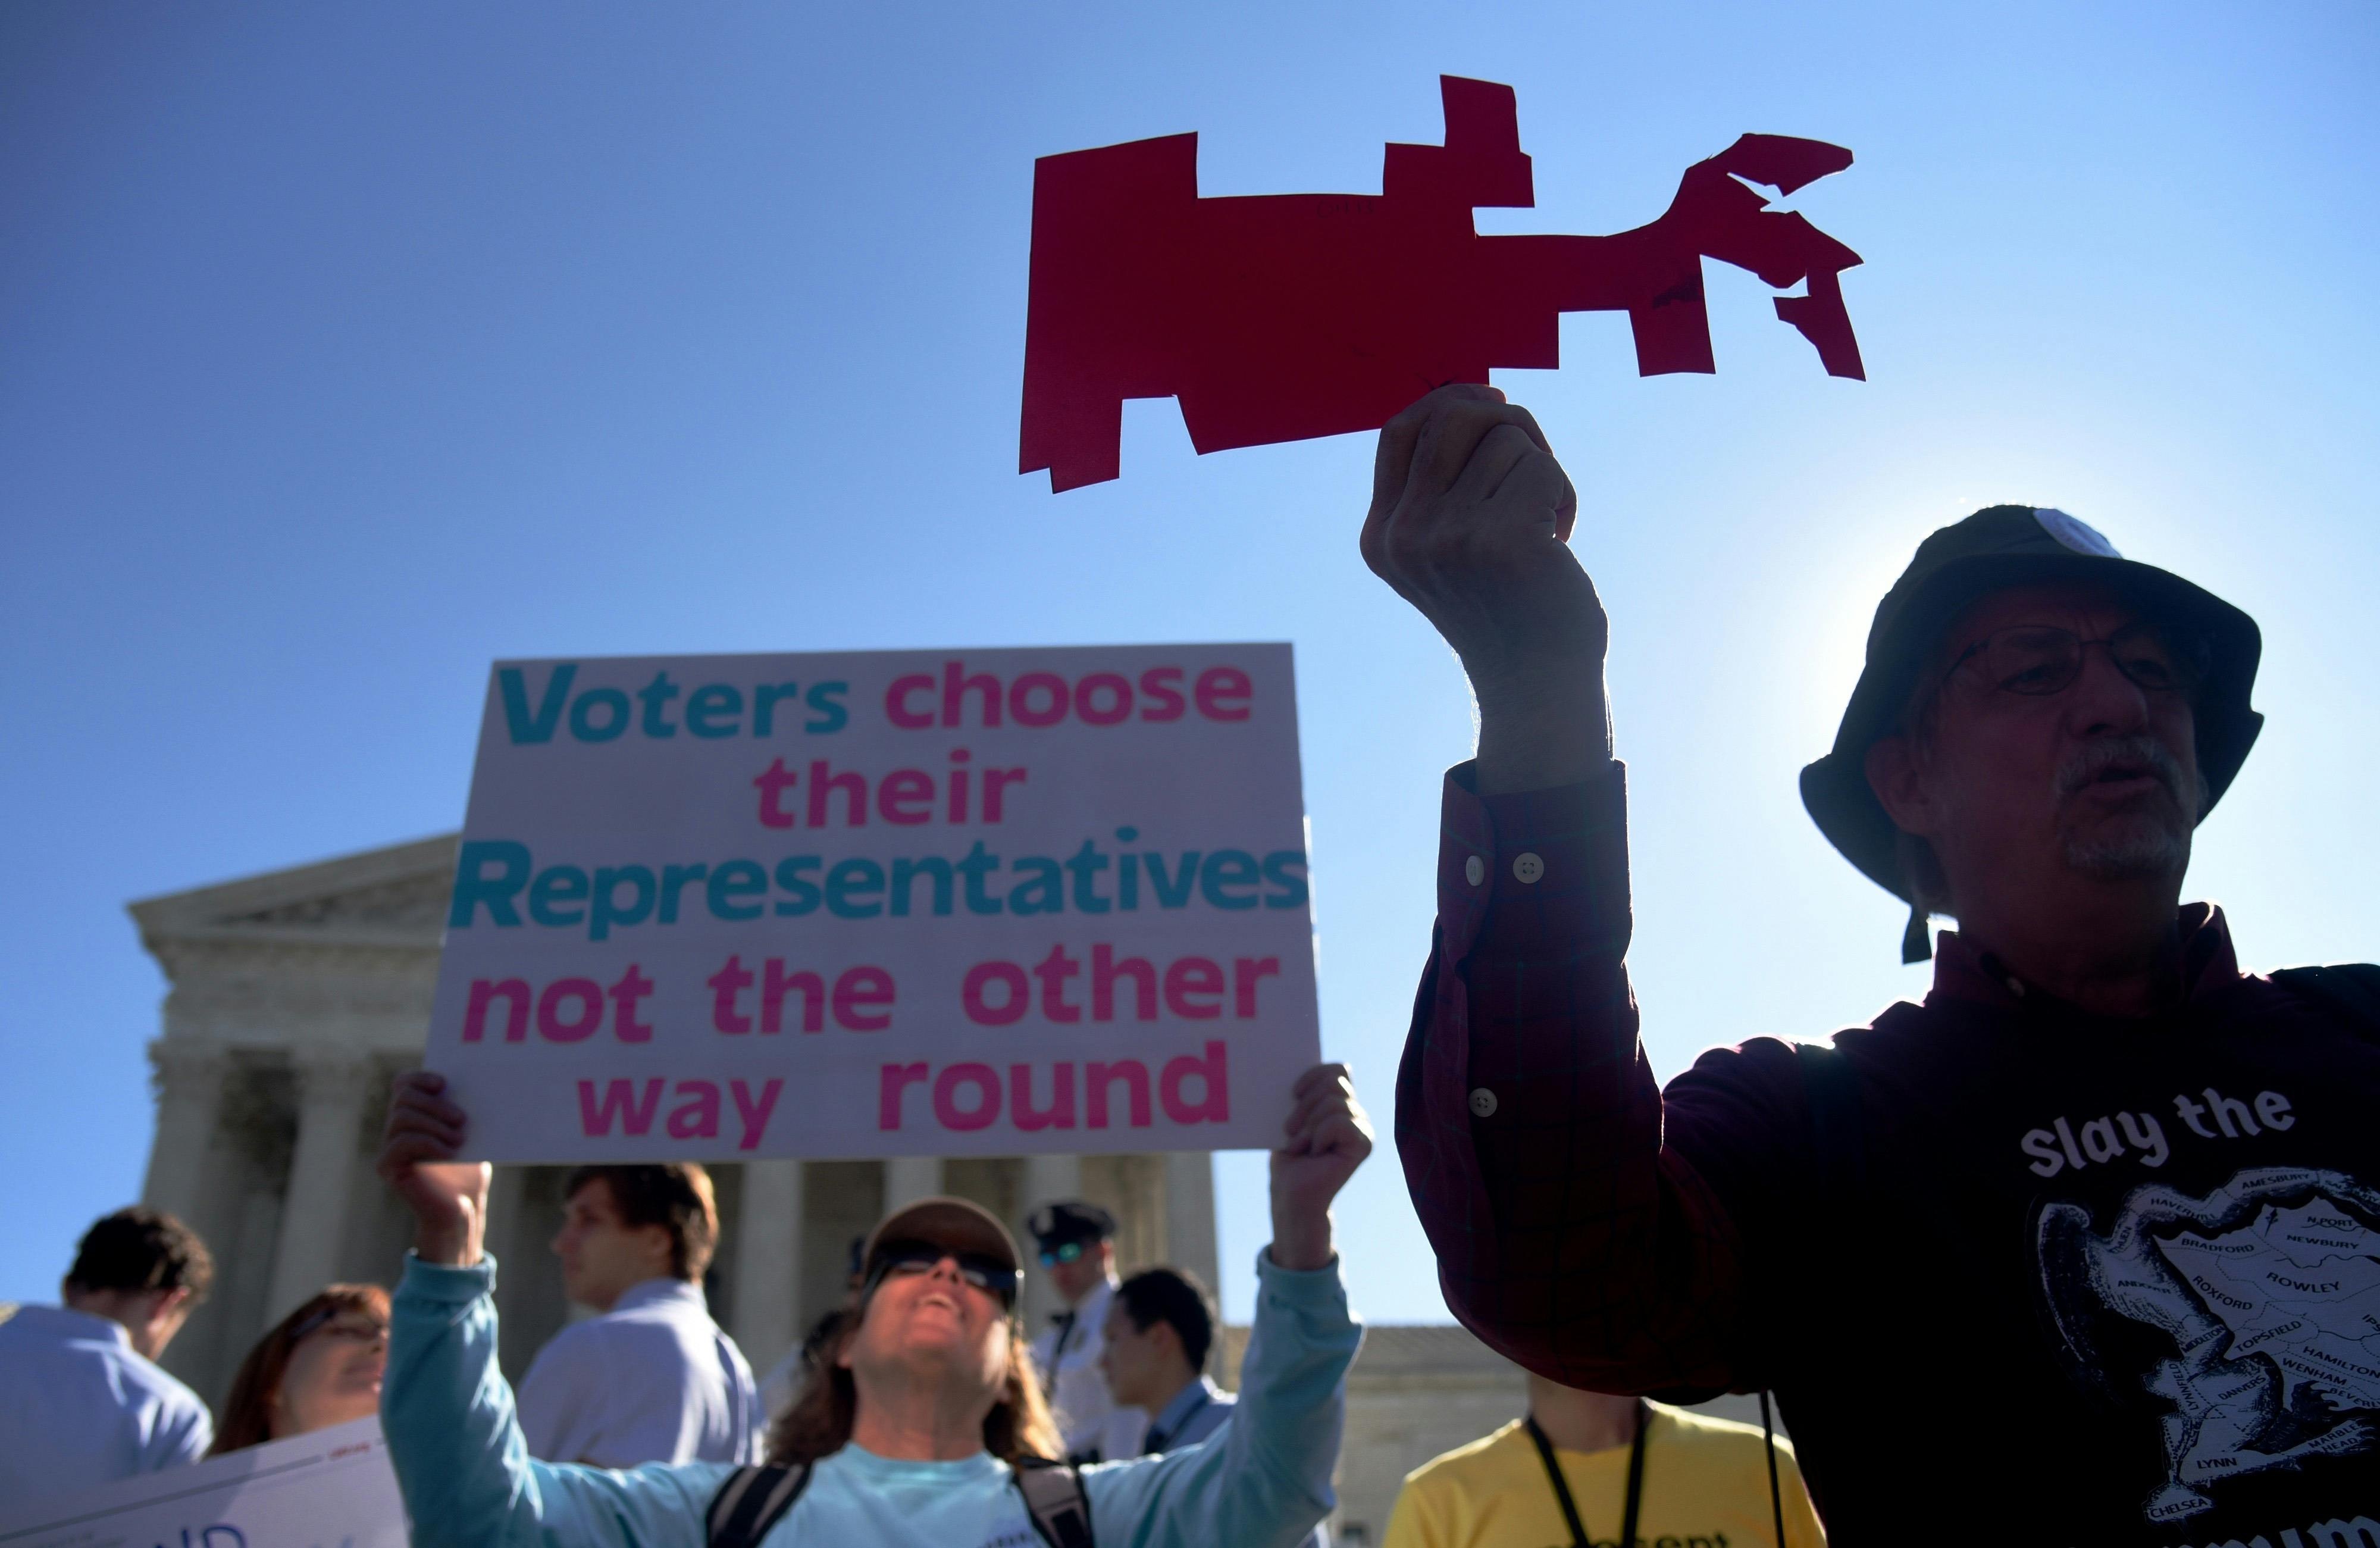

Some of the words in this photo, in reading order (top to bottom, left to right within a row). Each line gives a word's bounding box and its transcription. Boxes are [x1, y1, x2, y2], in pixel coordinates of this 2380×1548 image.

[499, 663, 849, 745] Voters
[885, 662, 1252, 729] choose
[754, 749, 1026, 828] their
[448, 826, 1309, 941] Representatives
[464, 964, 653, 1043] not
[708, 956, 895, 1034] the
[962, 943, 1279, 1026] other
[578, 1077, 783, 1151] way
[879, 1039, 1230, 1133] round
[2173, 1087, 2296, 1139] the
[2242, 1173, 2310, 1190] AMESBURY
[2182, 1238, 2254, 1253] BRADFORD
[2287, 1234, 2360, 1250] NEWBURY
[2266, 1271, 2340, 1293] ROWLEY
[2181, 1325, 2226, 1353] MIDDLETON
[2235, 1320, 2302, 1353] TOPSFIELD
[2282, 1357, 2348, 1386] WENHAM
[2169, 1363, 2200, 1411] LYNNFIELD
[2218, 1376, 2267, 1401] DANVERS
[2197, 1457, 2237, 1469] LYNN
[2150, 1498, 2209, 1518] CHELSEA
